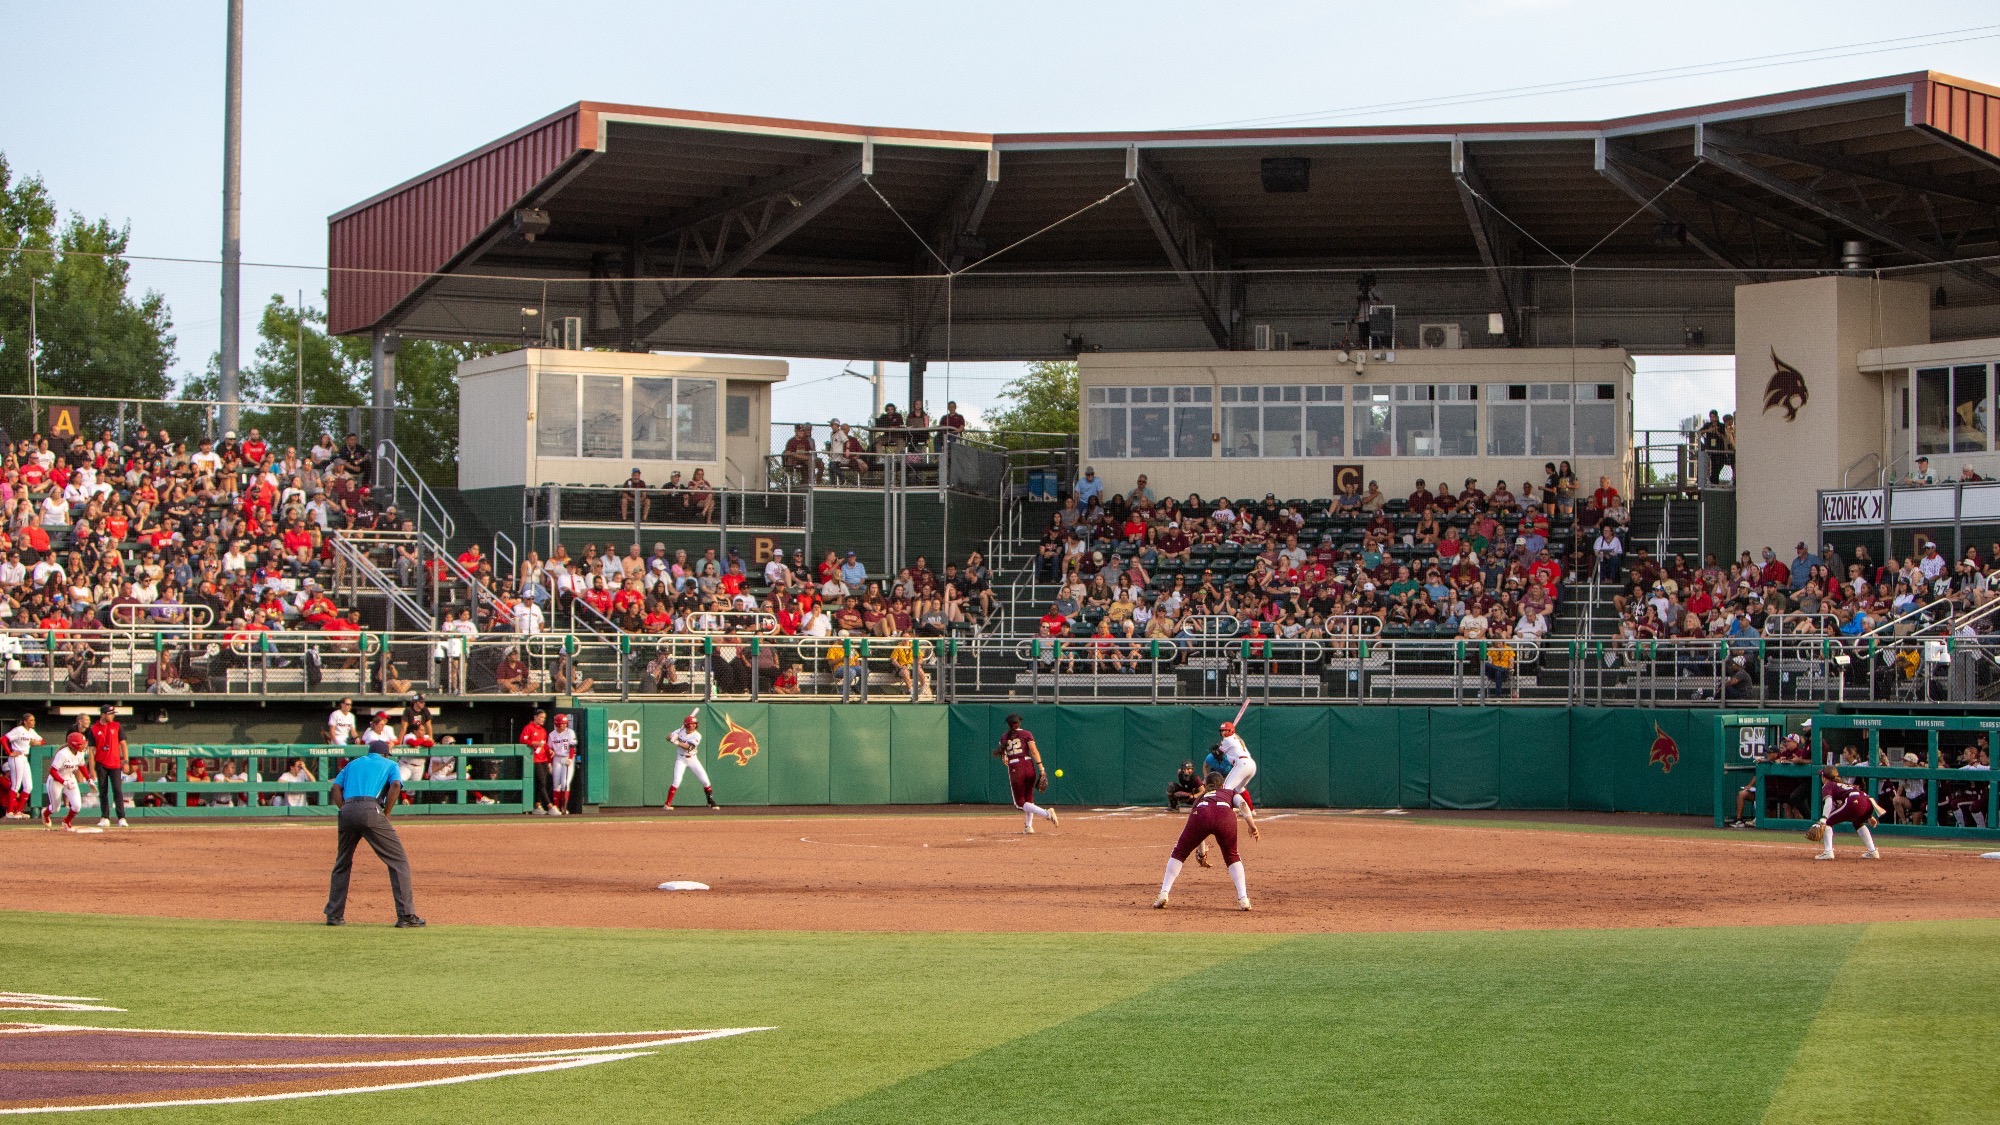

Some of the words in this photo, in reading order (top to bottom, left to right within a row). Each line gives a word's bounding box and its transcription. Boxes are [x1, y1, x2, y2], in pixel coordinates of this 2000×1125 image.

[56, 409, 76, 435] A
[1336, 467, 1359, 494] C
[1823, 496, 1857, 521] K-ZONE
[1857, 496, 1869, 519] K
[755, 537, 774, 563] B
[1913, 533, 1929, 561] D
[172, 748, 190, 756] STATE
[231, 748, 250, 756] TEXAS
